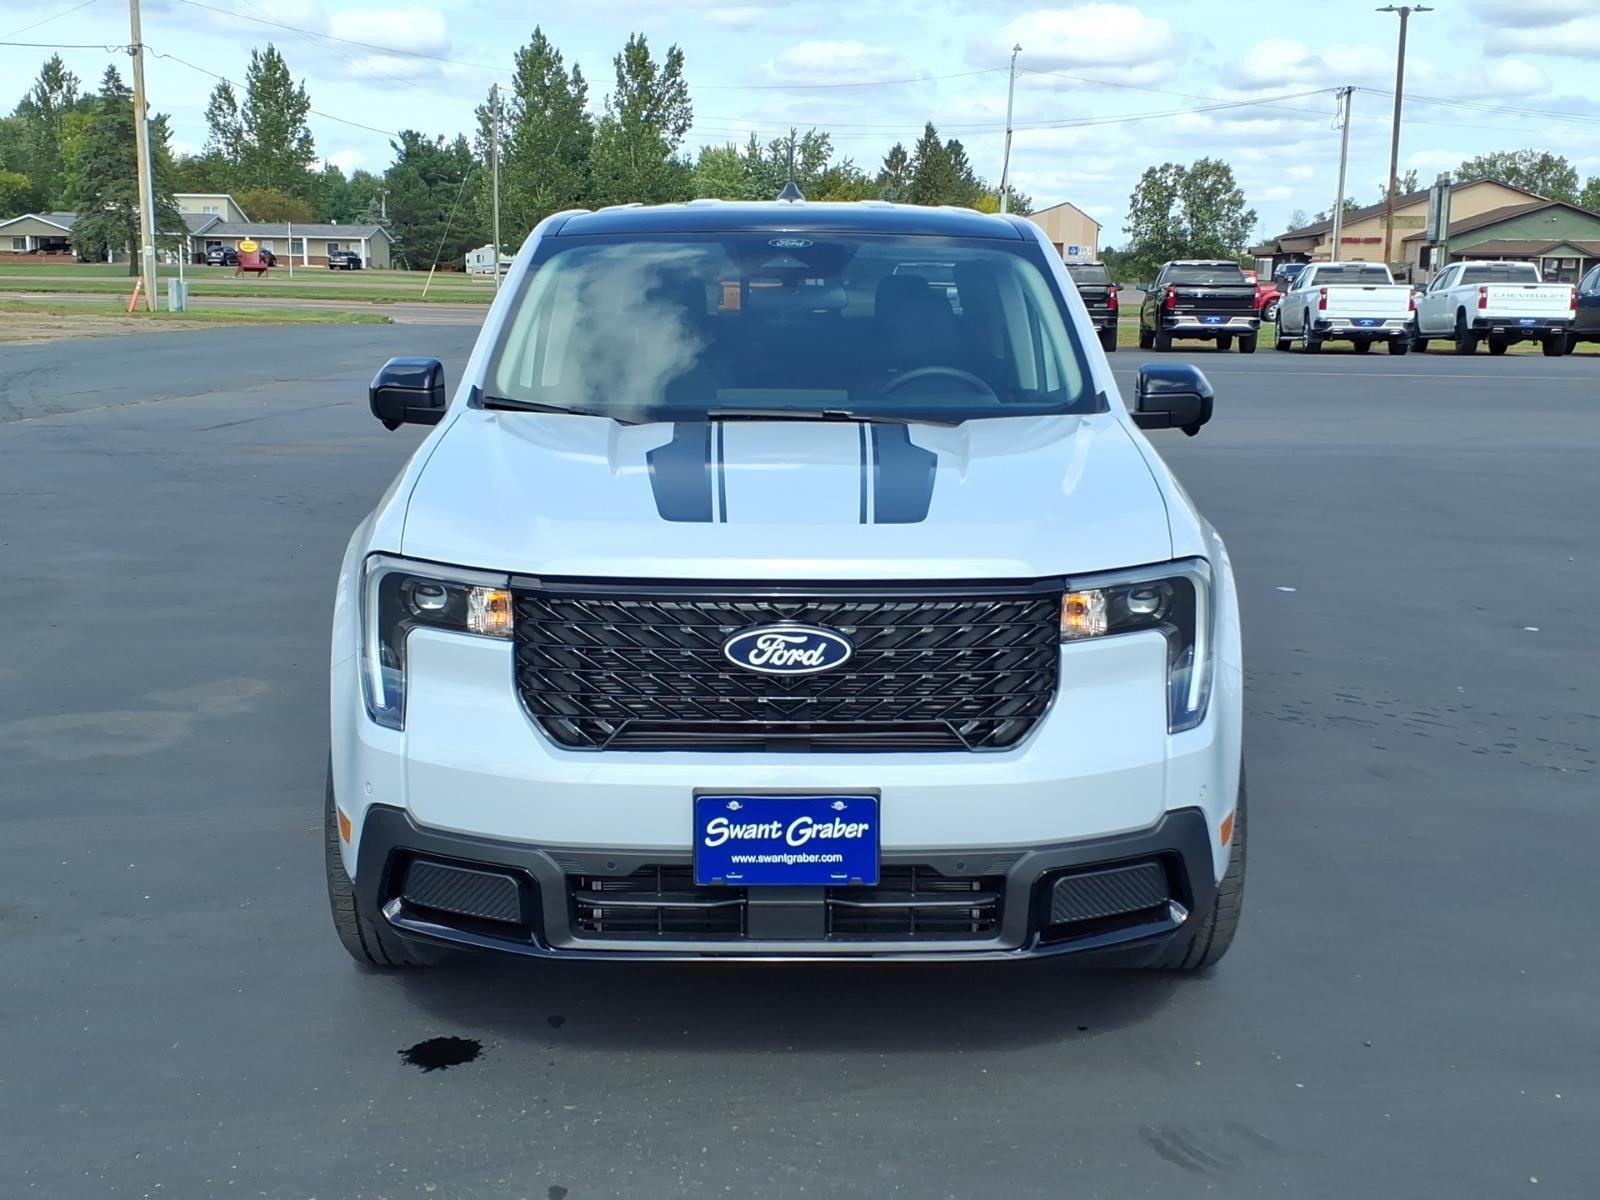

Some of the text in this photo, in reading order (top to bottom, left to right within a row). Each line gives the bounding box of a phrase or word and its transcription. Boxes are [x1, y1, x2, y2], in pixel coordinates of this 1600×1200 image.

[748, 633, 827, 666] Ford
[704, 816, 869, 847] Swant Graber
[731, 853, 843, 865] www.swantgraber.com
